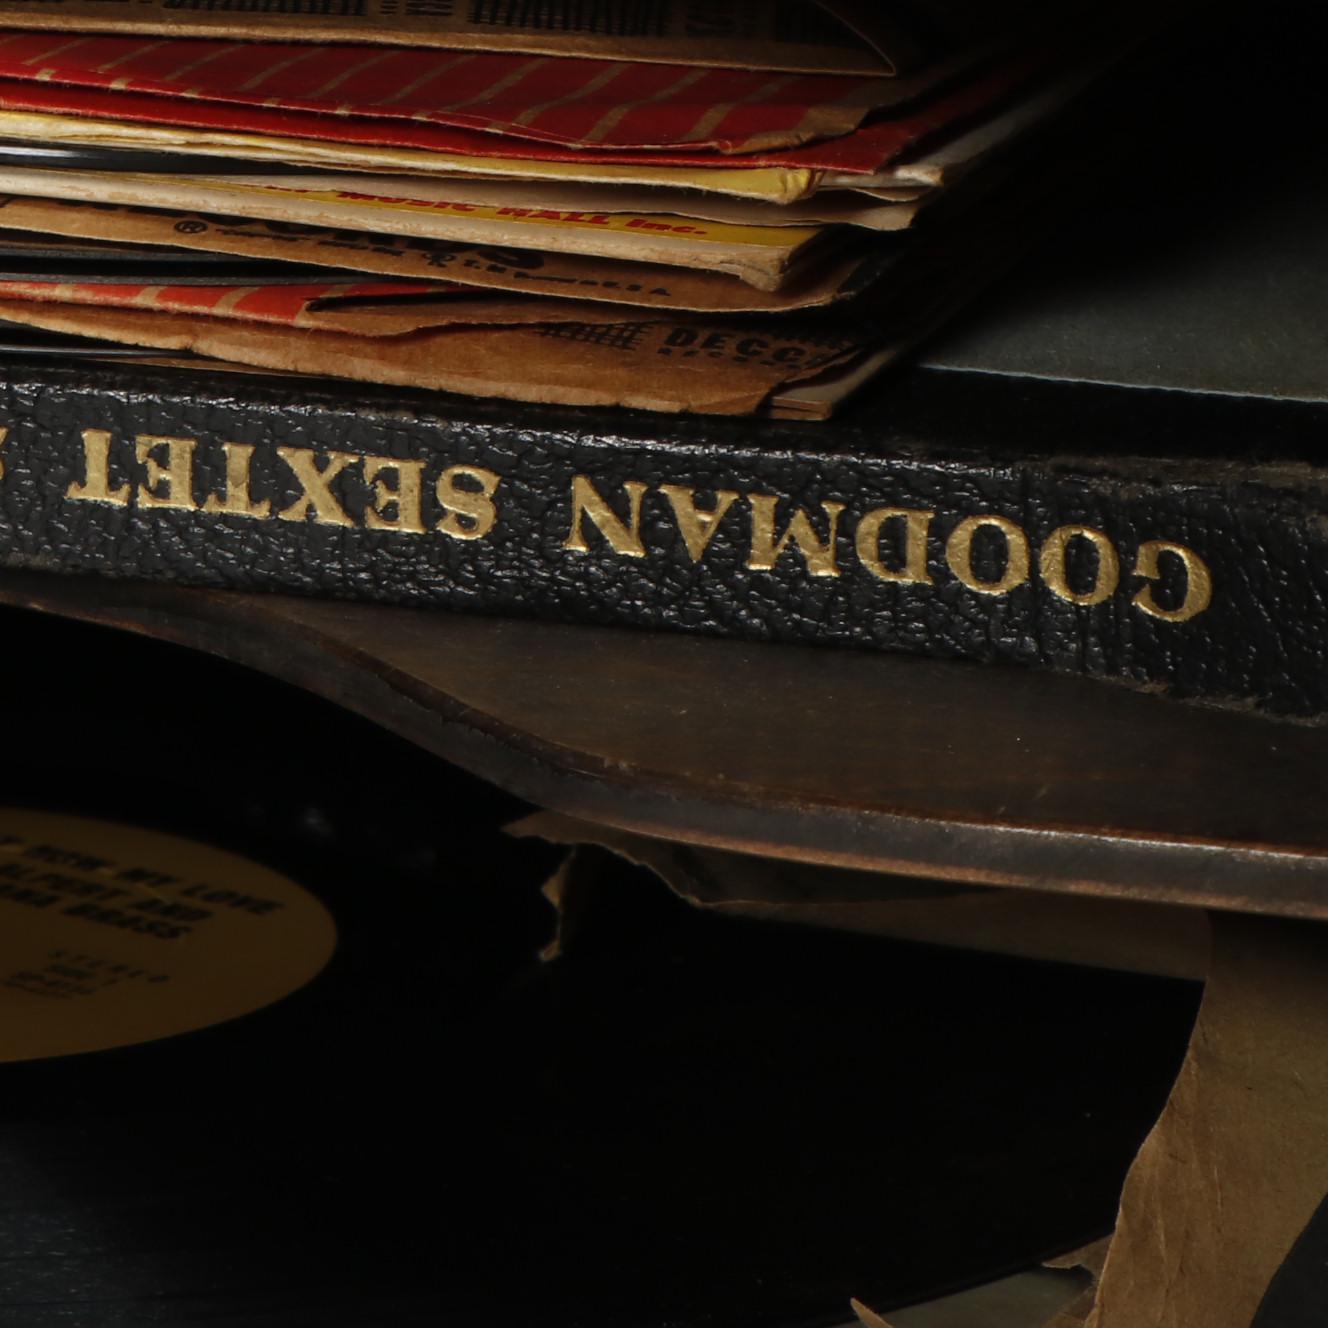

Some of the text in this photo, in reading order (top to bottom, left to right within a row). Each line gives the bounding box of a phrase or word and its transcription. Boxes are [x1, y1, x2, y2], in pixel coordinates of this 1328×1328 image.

[496, 206, 610, 226] HALL
[624, 217, 708, 236] Inc.
[63, 428, 502, 541] SEXTET
[563, 474, 1213, 623] GOODMAN
[180, 884, 285, 915] LOVE
